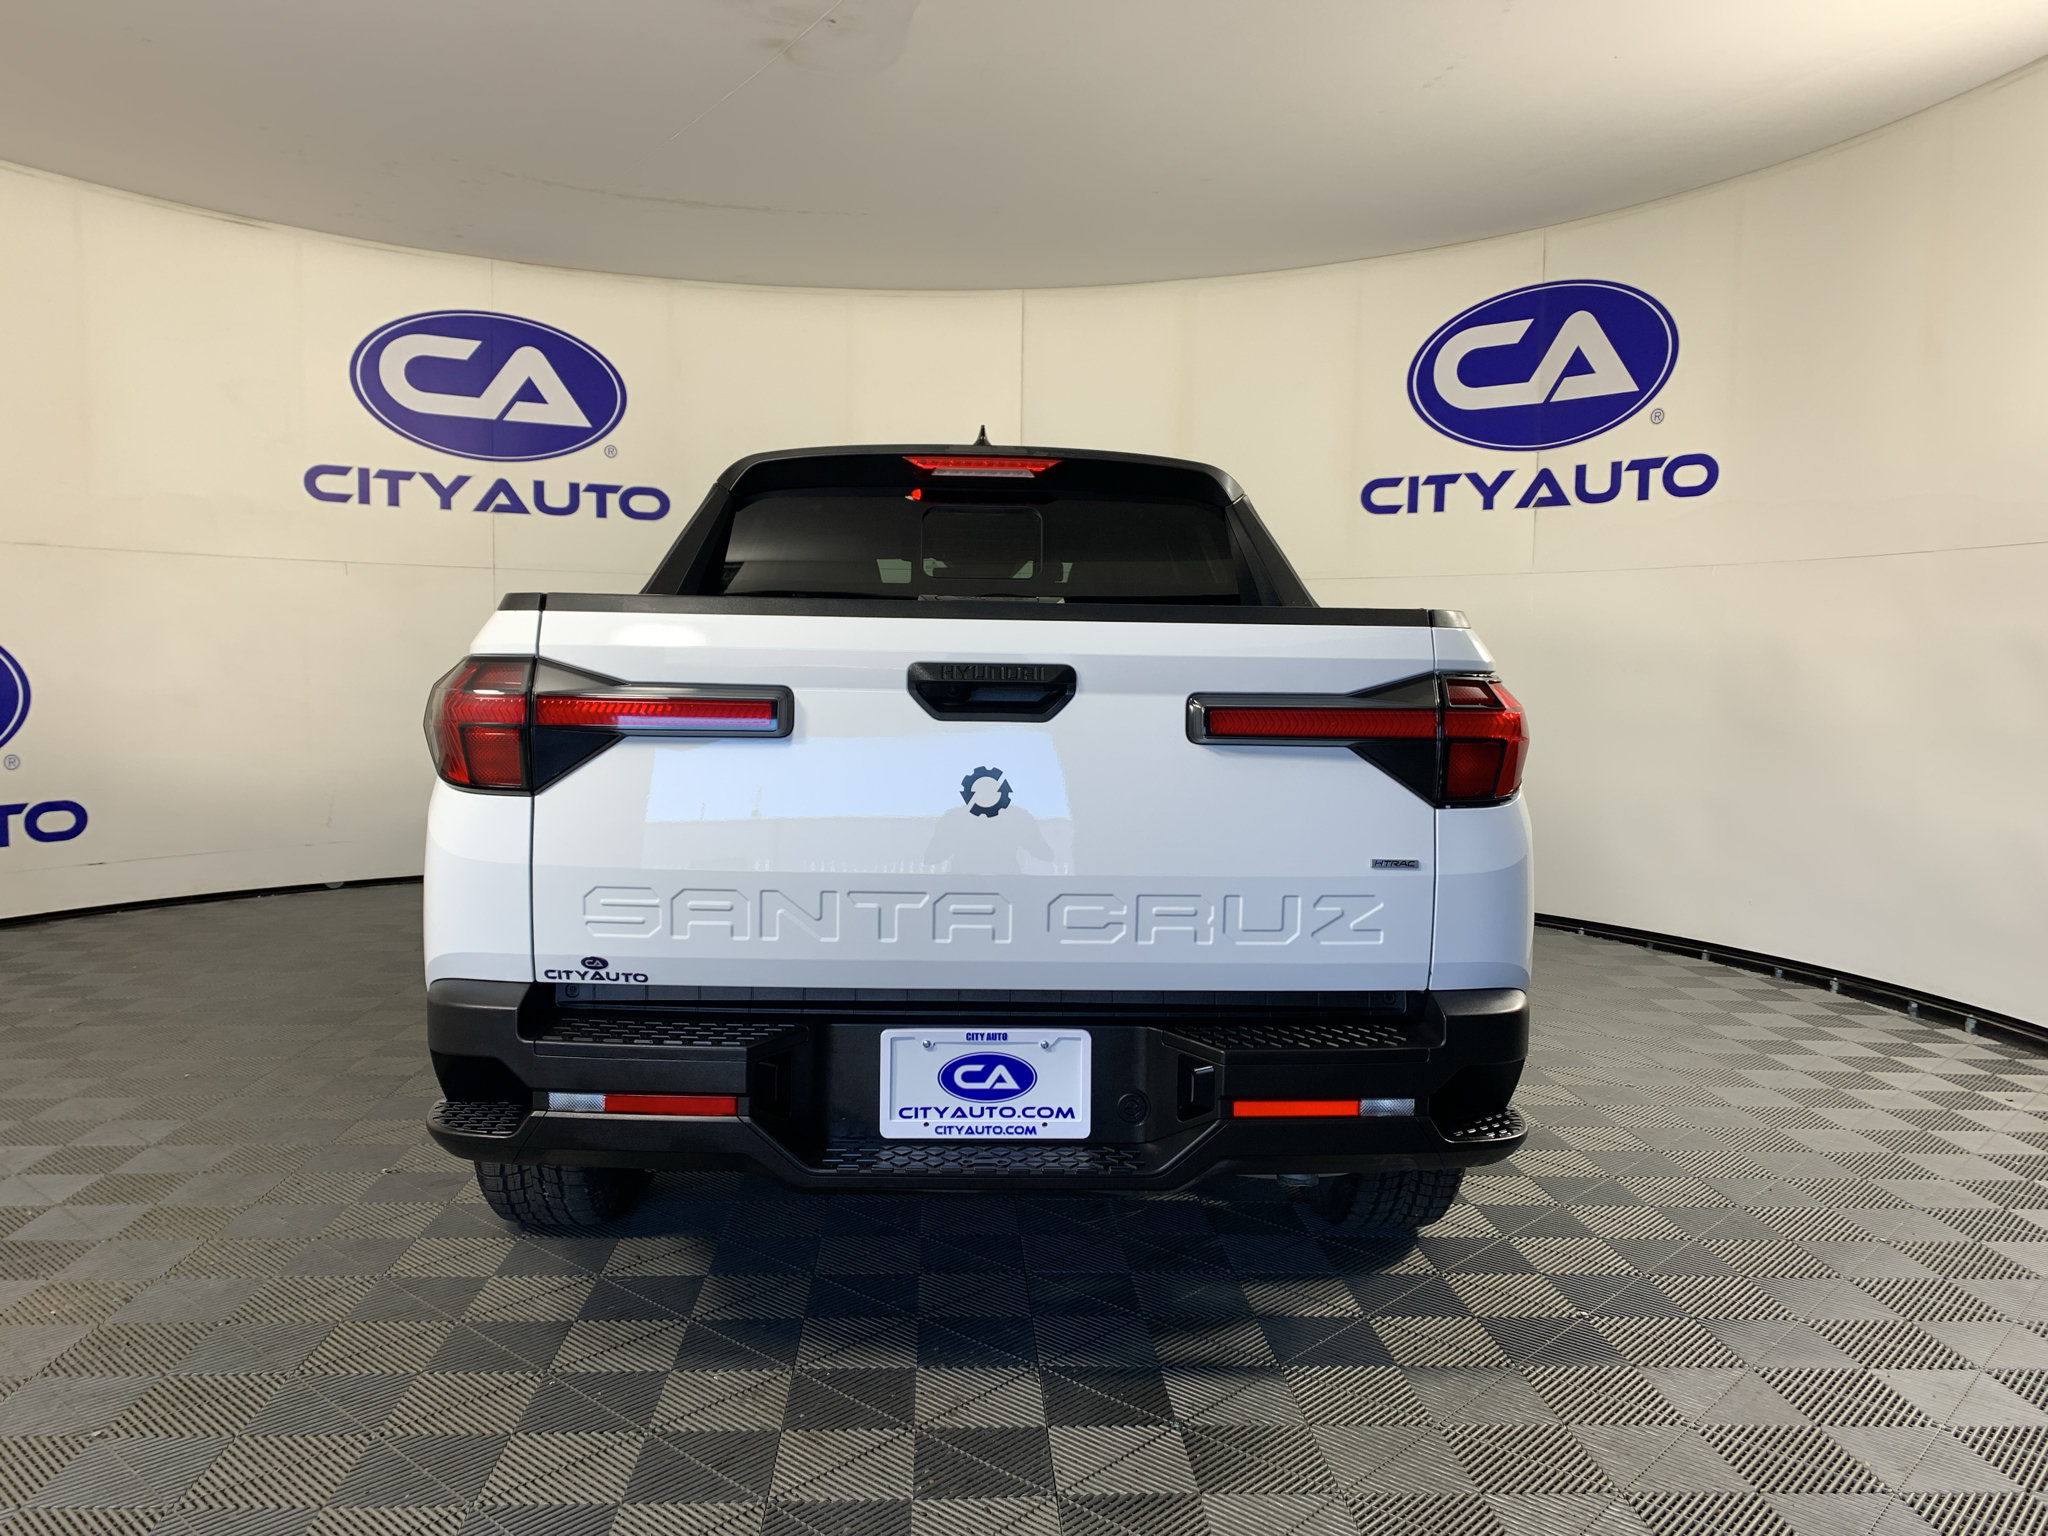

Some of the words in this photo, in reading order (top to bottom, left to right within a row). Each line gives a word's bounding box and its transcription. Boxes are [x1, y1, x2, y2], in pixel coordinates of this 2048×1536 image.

[1433, 310, 1640, 411] CA
[378, 333, 593, 428] CA
[941, 664, 1045, 680] HYUNDAI
[583, 886, 1012, 944] SANTA
[1047, 893, 1384, 945] CRUZ
[965, 1032, 986, 1041] CITY
[986, 1032, 1008, 1041] AUTO
[953, 1064, 1021, 1090] CA
[898, 1106, 1076, 1119] CITYAUTO.COM
[934, 1125, 1037, 1135] CITYAUTO.COM
